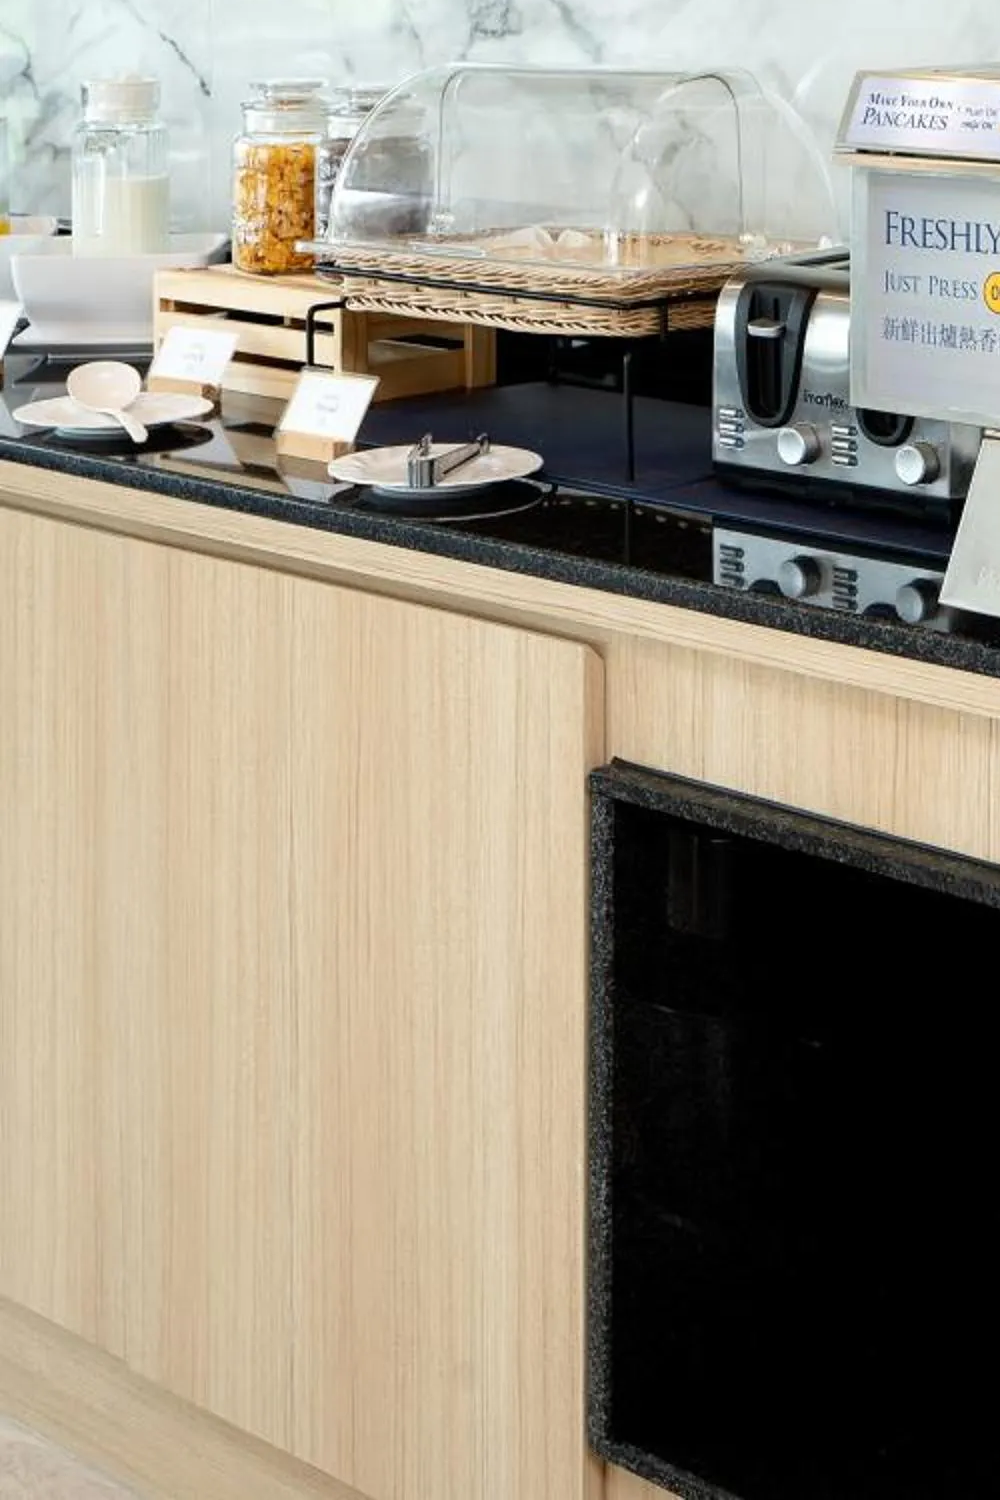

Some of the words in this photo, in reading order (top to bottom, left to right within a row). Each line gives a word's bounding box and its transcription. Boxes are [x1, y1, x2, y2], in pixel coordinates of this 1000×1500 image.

[862, 107, 949, 131] PANCAKES
[884, 270, 921, 294] JUST
[929, 275, 977, 300] PRESS
